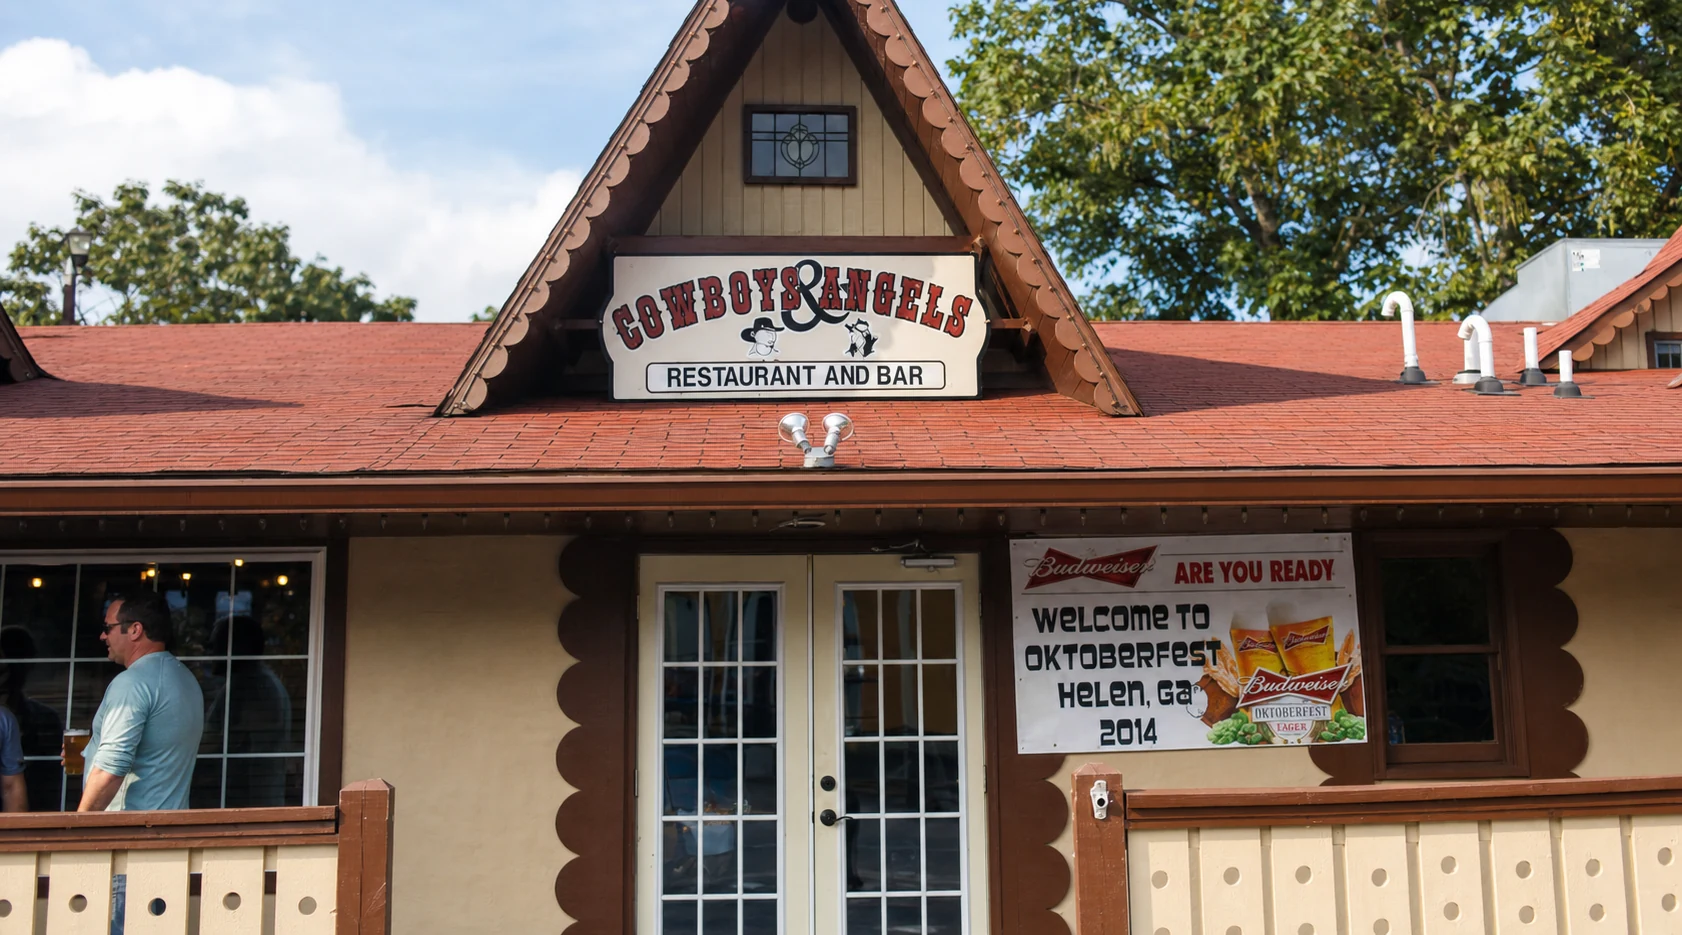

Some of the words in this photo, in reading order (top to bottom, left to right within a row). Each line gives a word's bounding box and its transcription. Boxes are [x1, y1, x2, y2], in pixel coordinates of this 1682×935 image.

[612, 265, 801, 350] COWBOYS
[781, 258, 850, 332] &
[820, 265, 974, 338] ANGELS
[667, 365, 815, 387] RESTAURANT
[824, 365, 870, 386] AND
[877, 365, 924, 386] BAR
[1023, 556, 1157, 578] Budweiser
[1174, 561, 1215, 584] ARE
[1222, 560, 1263, 583] YOU
[1270, 558, 1335, 582] READY
[1176, 603, 1210, 630] TO
[1237, 675, 1348, 695] Budweiser
[1254, 705, 1328, 719] OKTOBERFEST
[1100, 718, 1158, 746] 2014
[1277, 722, 1308, 732] LAGER
